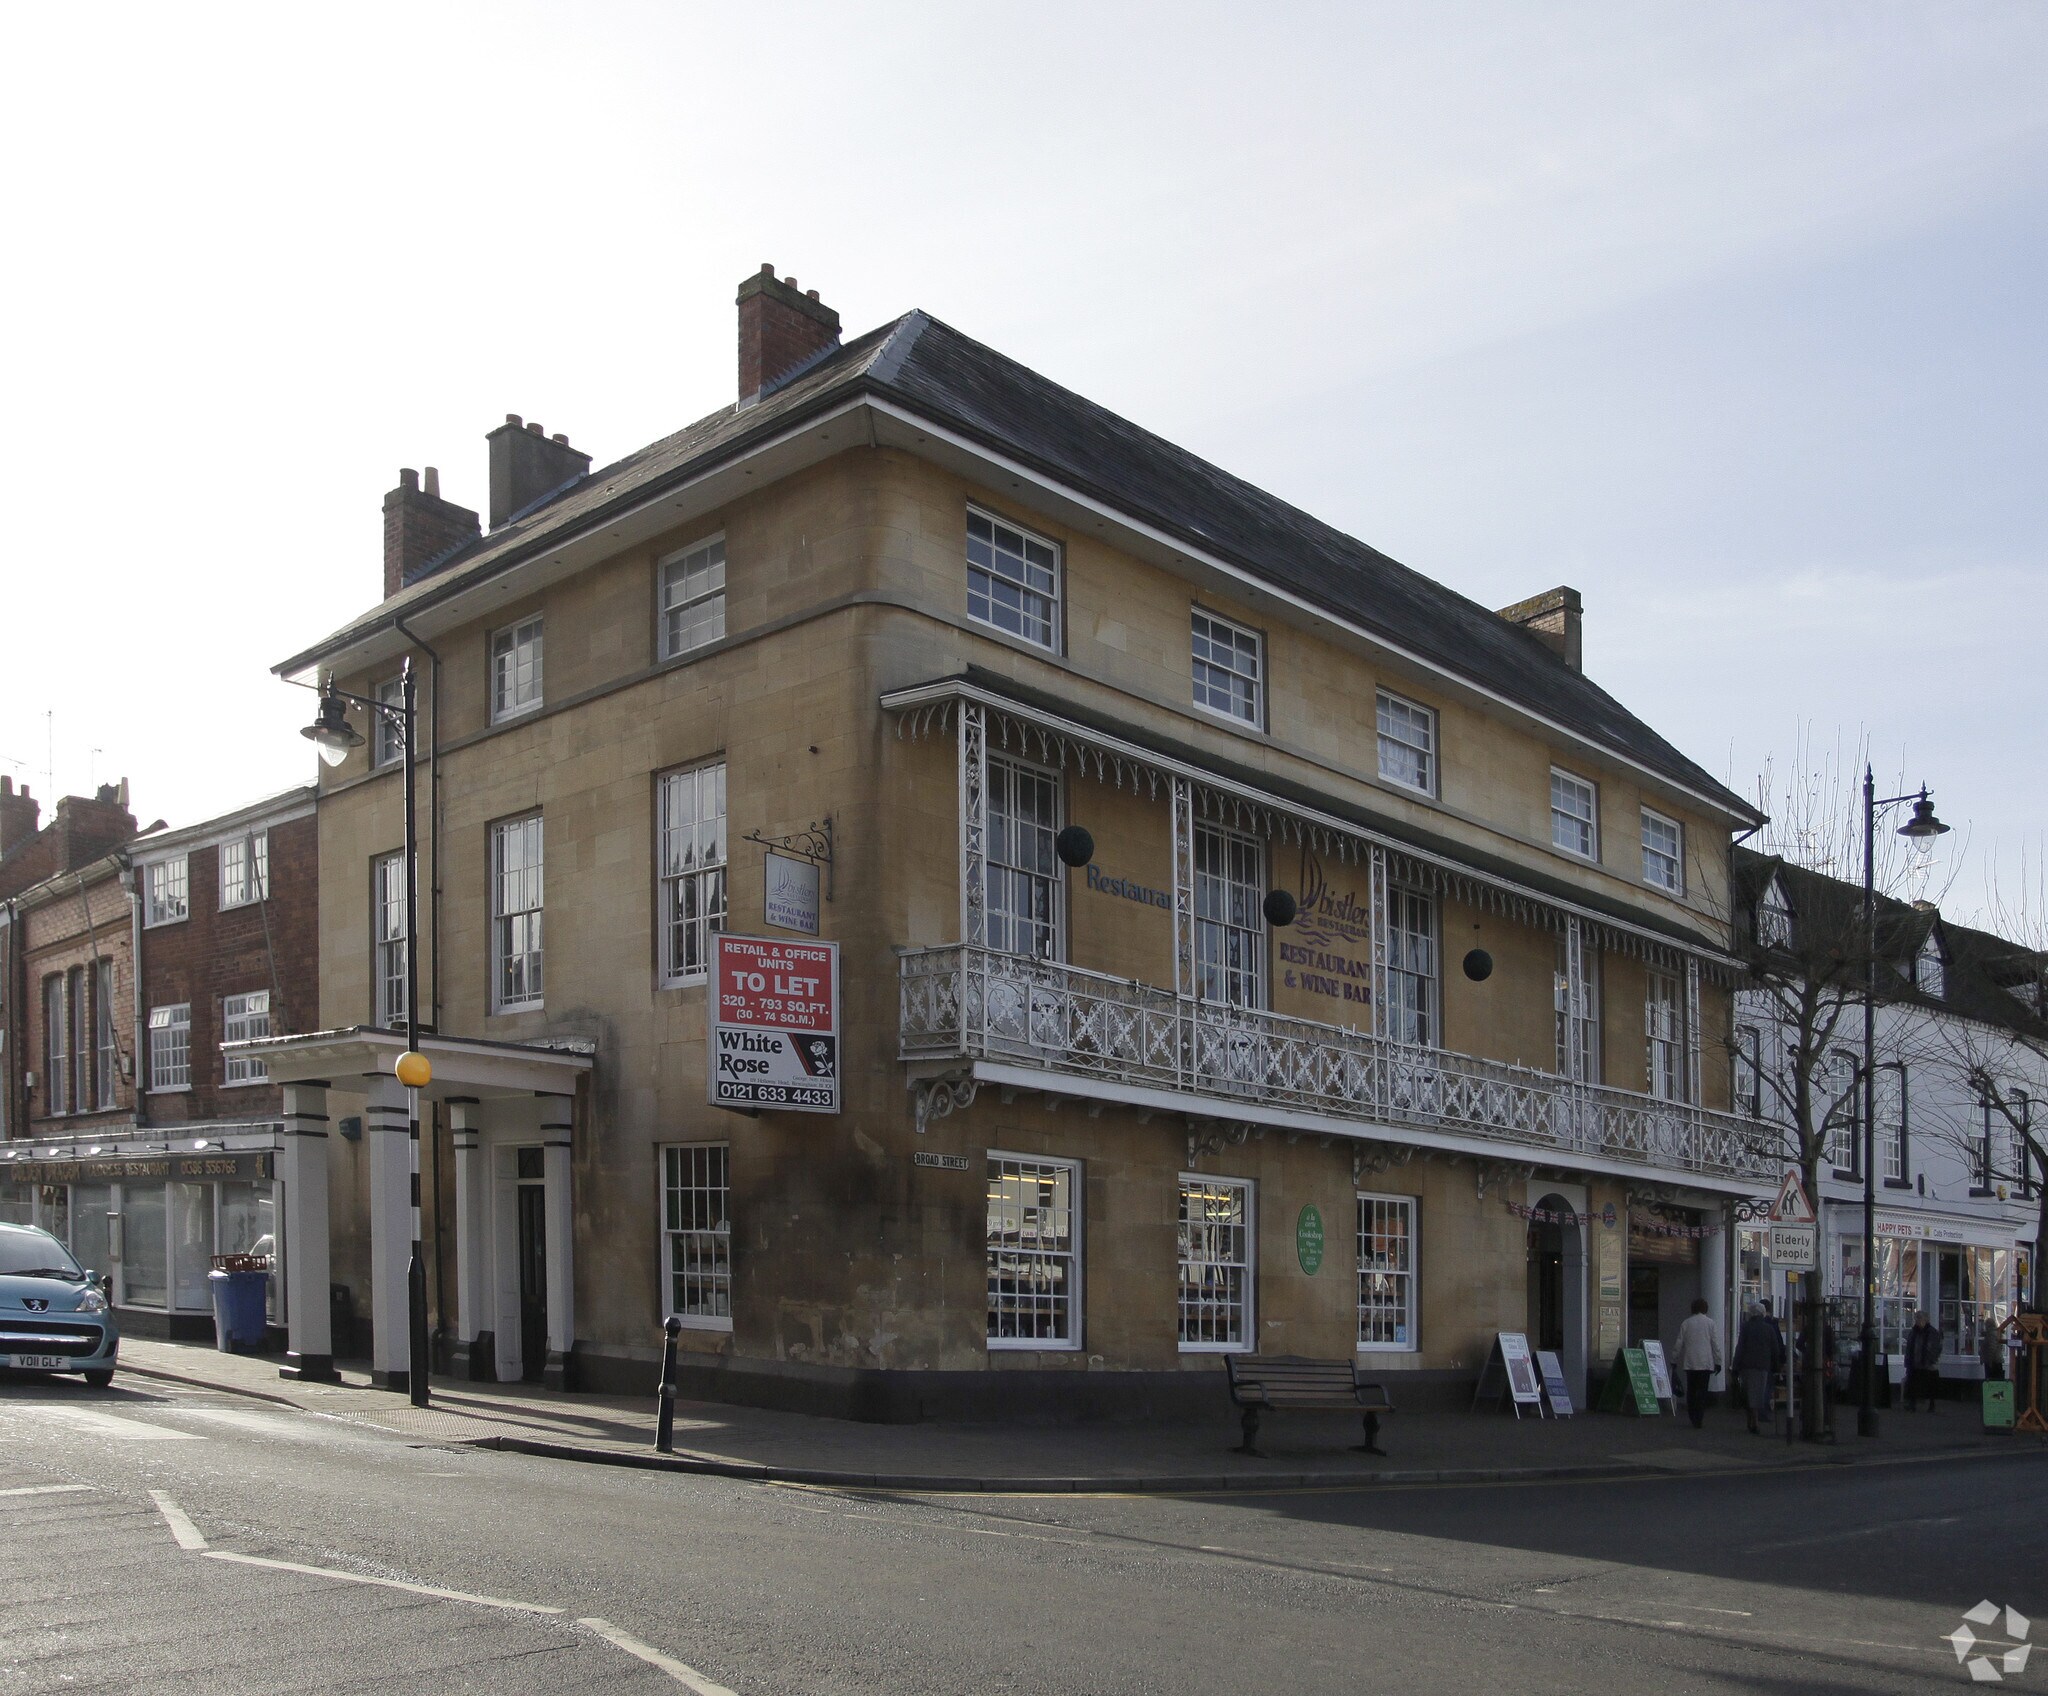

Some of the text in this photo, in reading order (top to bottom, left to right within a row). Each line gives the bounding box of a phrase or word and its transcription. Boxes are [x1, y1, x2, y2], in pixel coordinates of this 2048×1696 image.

[778, 914, 796, 925] WINE
[800, 920, 814, 929] BAR
[724, 942, 826, 962] RETAIL & OFFICE
[758, 958, 794, 970] UNITS
[732, 971, 819, 997] TO LET
[1284, 970, 1370, 1004] & WINE BAR
[722, 995, 745, 1006] 320
[759, 998, 782, 1010] 793
[787, 1002, 829, 1014] SQ.FT.
[736, 1009, 753, 1020] (30
[764, 1012, 776, 1021] 74
[780, 1014, 815, 1026] SQ.M.)
[719, 1032, 782, 1054] White
[720, 1054, 769, 1080] Rose
[720, 1083, 830, 1105] 0121 633 4433
[916, 1153, 967, 1168] BROAD STREET
[1877, 1222, 1896, 1234] HAPPY
[1898, 1224, 1912, 1235] PETS
[1775, 1234, 1810, 1246] Elderly
[1776, 1249, 1809, 1260] people
[42, 1357, 62, 1367] GLF
